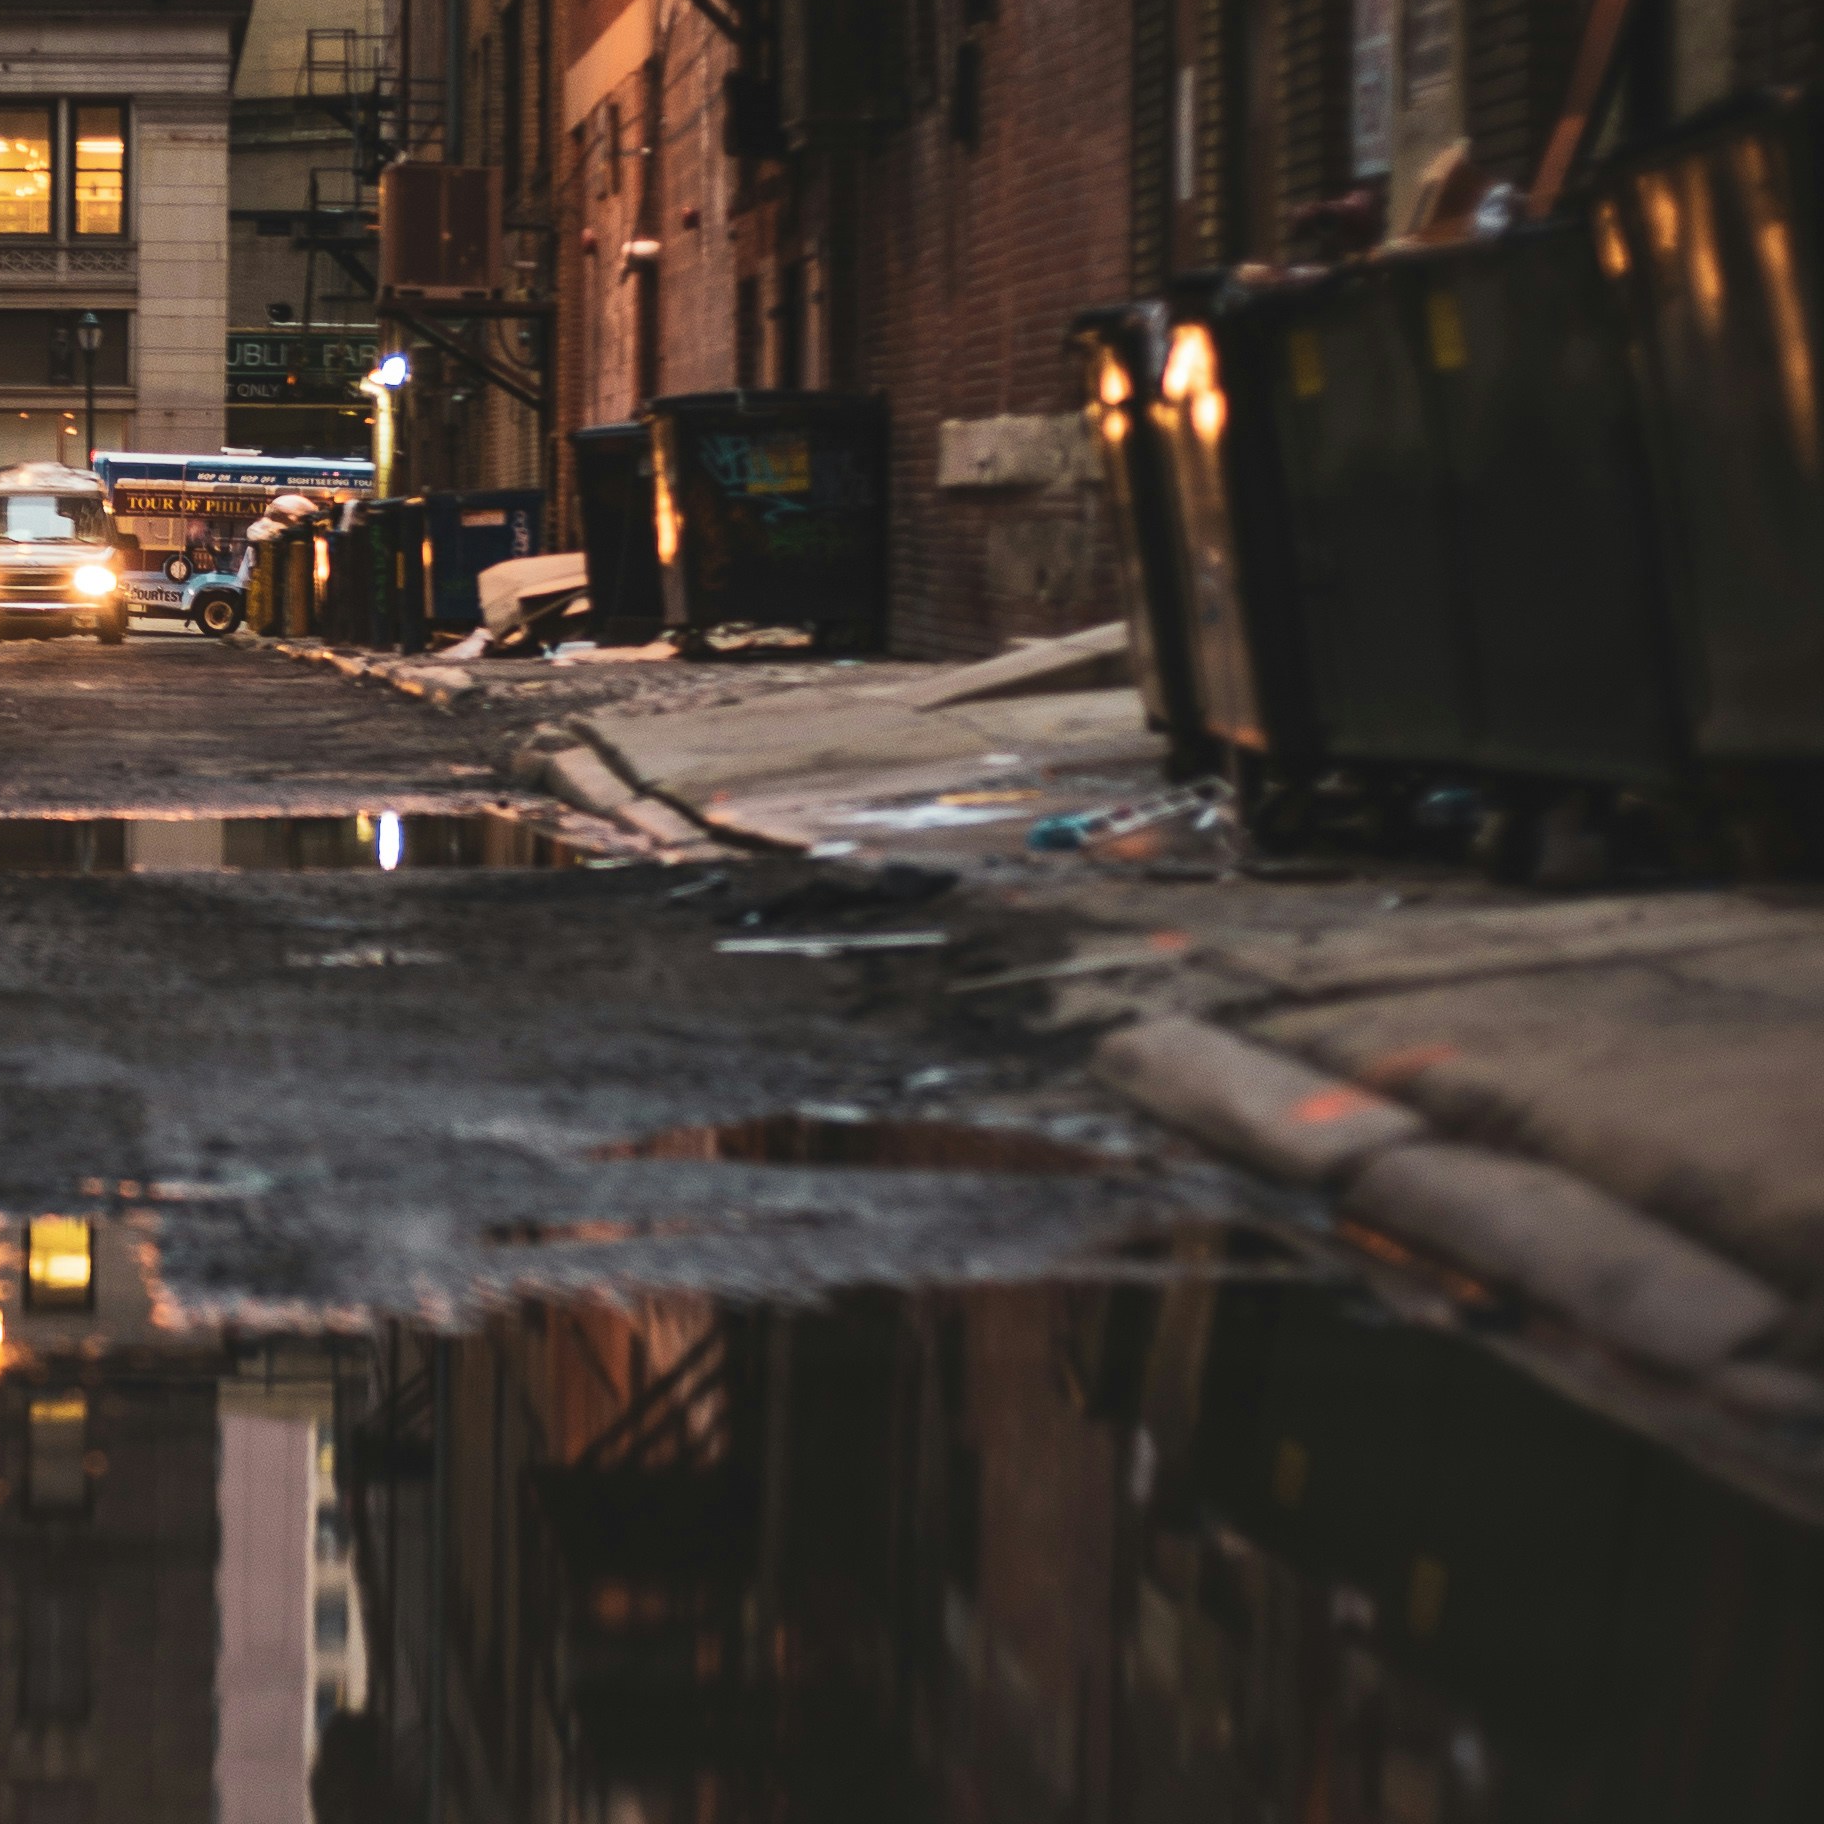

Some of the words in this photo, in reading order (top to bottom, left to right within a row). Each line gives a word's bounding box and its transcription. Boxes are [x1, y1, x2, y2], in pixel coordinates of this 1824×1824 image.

[226, 342, 306, 367] UBLI
[237, 384, 280, 397] ONLY
[260, 476, 277, 484] OFF
[287, 477, 350, 486] SIGHTSEEING
[127, 497, 173, 510] TOUR
[179, 499, 201, 511] OF
